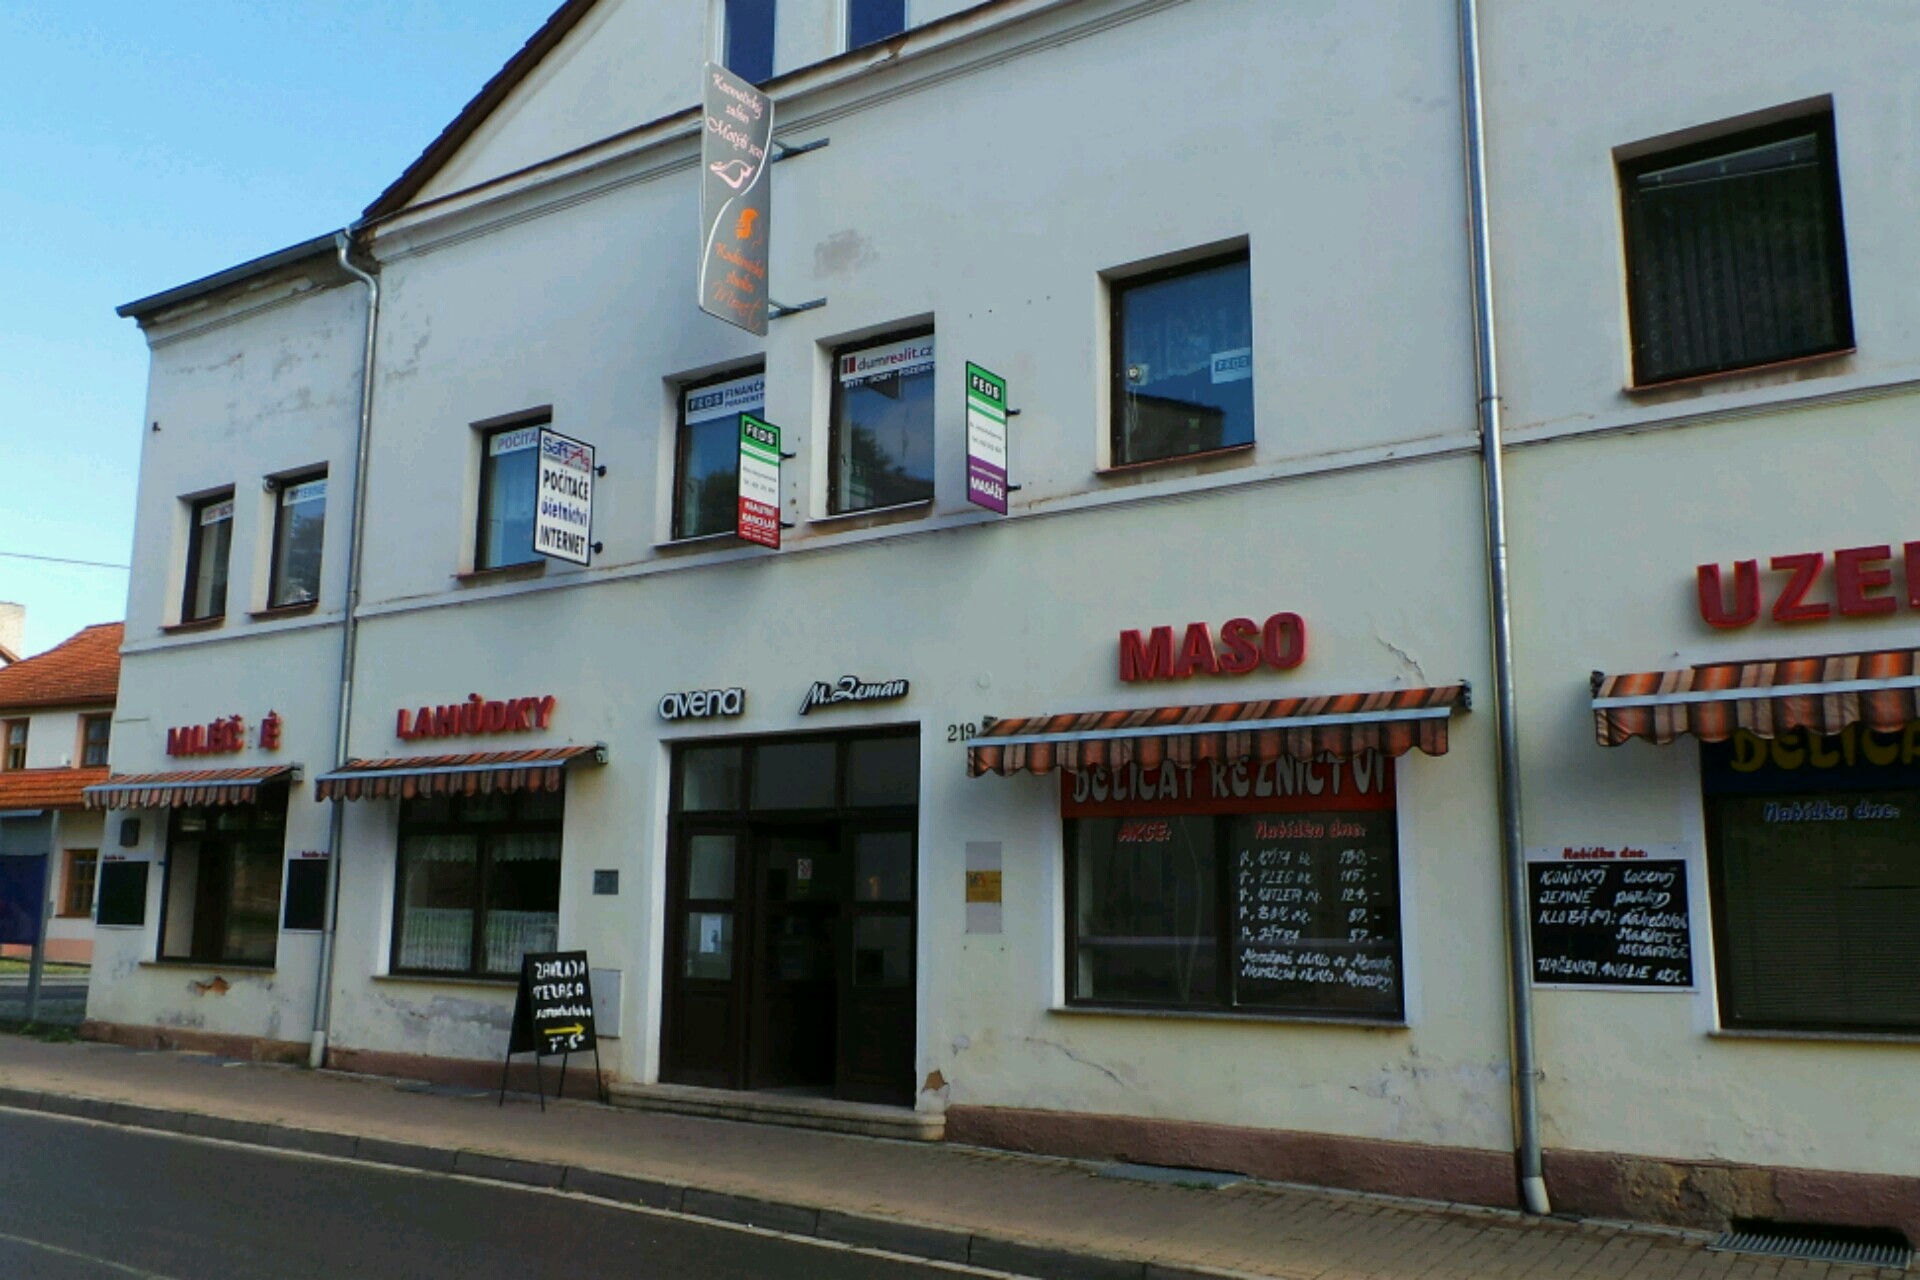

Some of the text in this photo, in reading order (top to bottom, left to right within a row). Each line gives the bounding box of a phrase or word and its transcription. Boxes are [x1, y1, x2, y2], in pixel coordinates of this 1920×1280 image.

[857, 346, 934, 371] dumrealit.cz
[972, 375, 1000, 400] FEDS
[689, 393, 723, 412] FEDS
[745, 423, 776, 446] FEDS
[543, 468, 589, 502] POČÍTAČE
[970, 476, 1004, 501] MASÁŽE
[541, 495, 588, 529] účetnictví
[539, 524, 586, 557] INTERNET
[1119, 612, 1308, 682] MASO
[396, 692, 557, 740] LAHŮDKY
[658, 686, 746, 721] avena
[947, 722, 977, 743] 219
[1762, 801, 1848, 823] Nabídka
[1254, 820, 1325, 839] Nabídka
[1562, 847, 1615, 860] Nabídka
